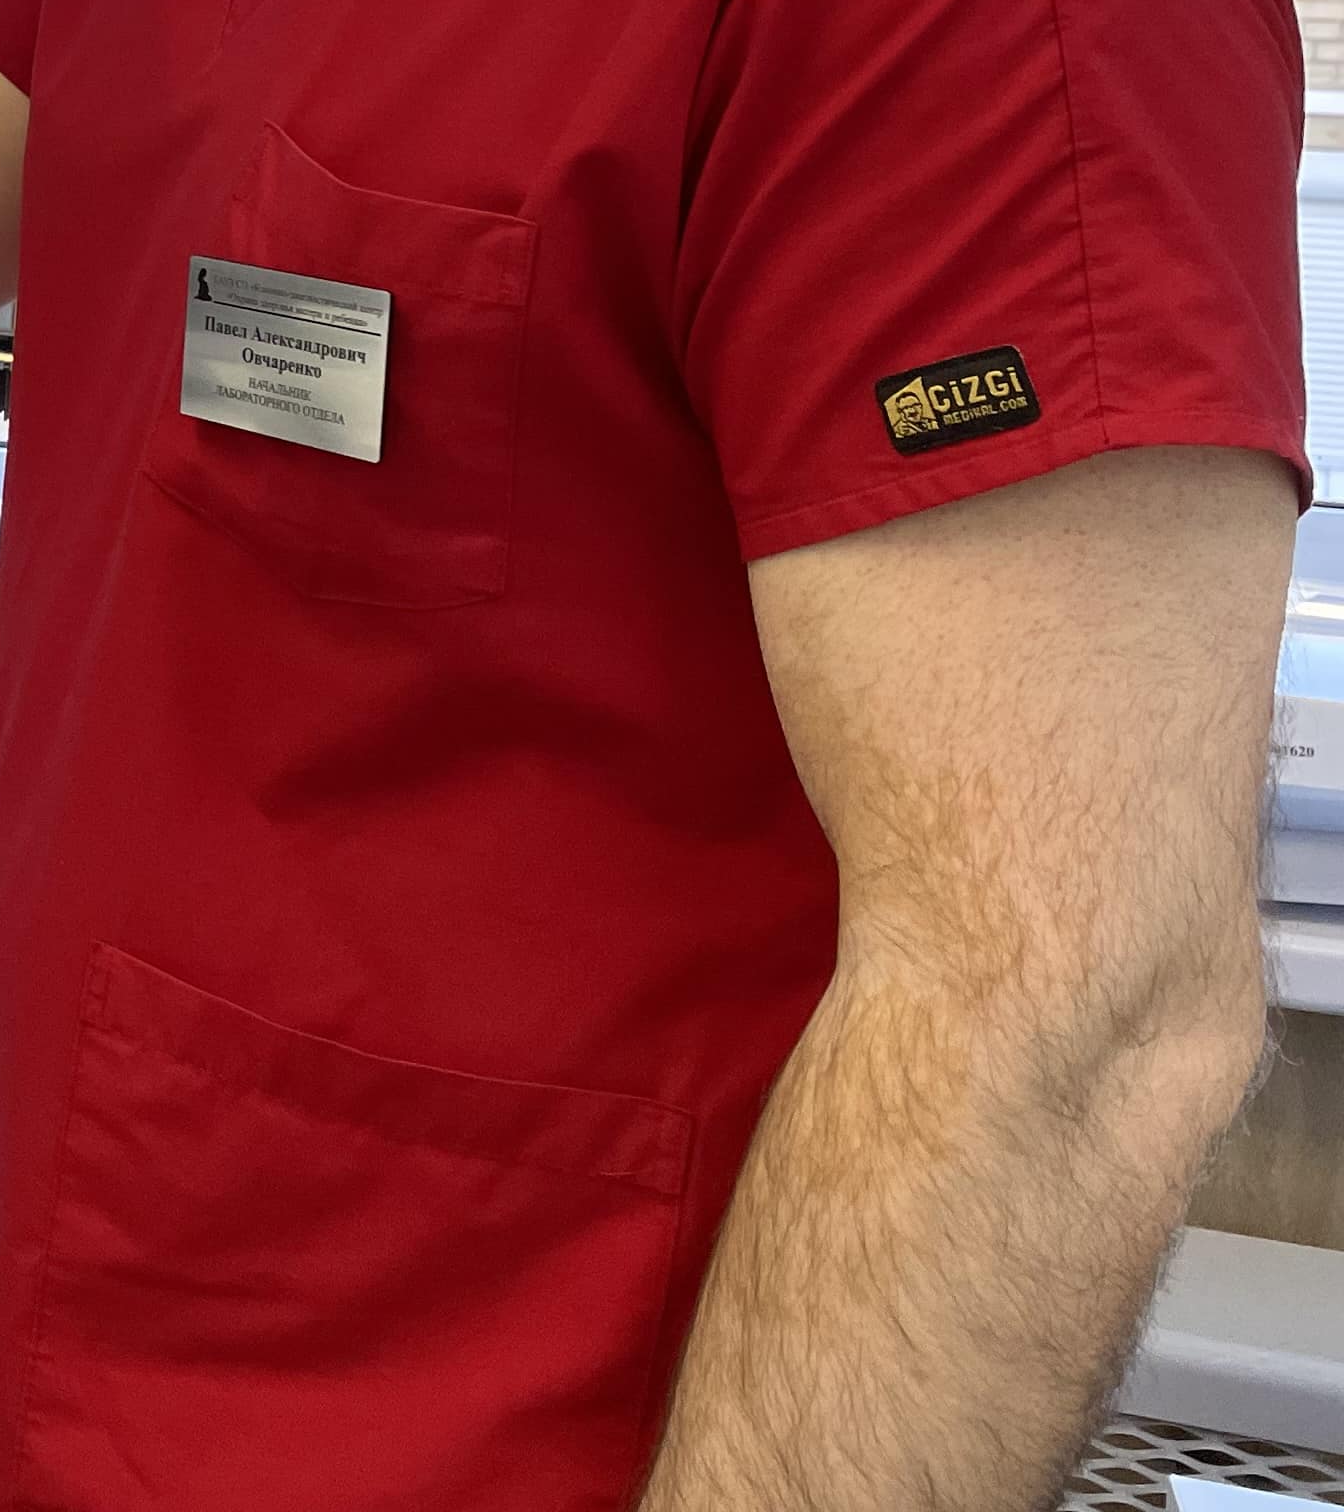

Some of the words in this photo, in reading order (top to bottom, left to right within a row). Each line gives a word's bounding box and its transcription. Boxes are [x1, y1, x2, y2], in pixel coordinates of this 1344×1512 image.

[204, 315, 248, 340] Павел
[251, 326, 367, 365] Александрович
[241, 346, 323, 379] Овчаренко
[215, 384, 301, 416] ЛАБОРАТОРНОГО
[302, 405, 346, 426] ОТДЕЛА
[247, 376, 313, 402] НАЧАЛЬНИК
